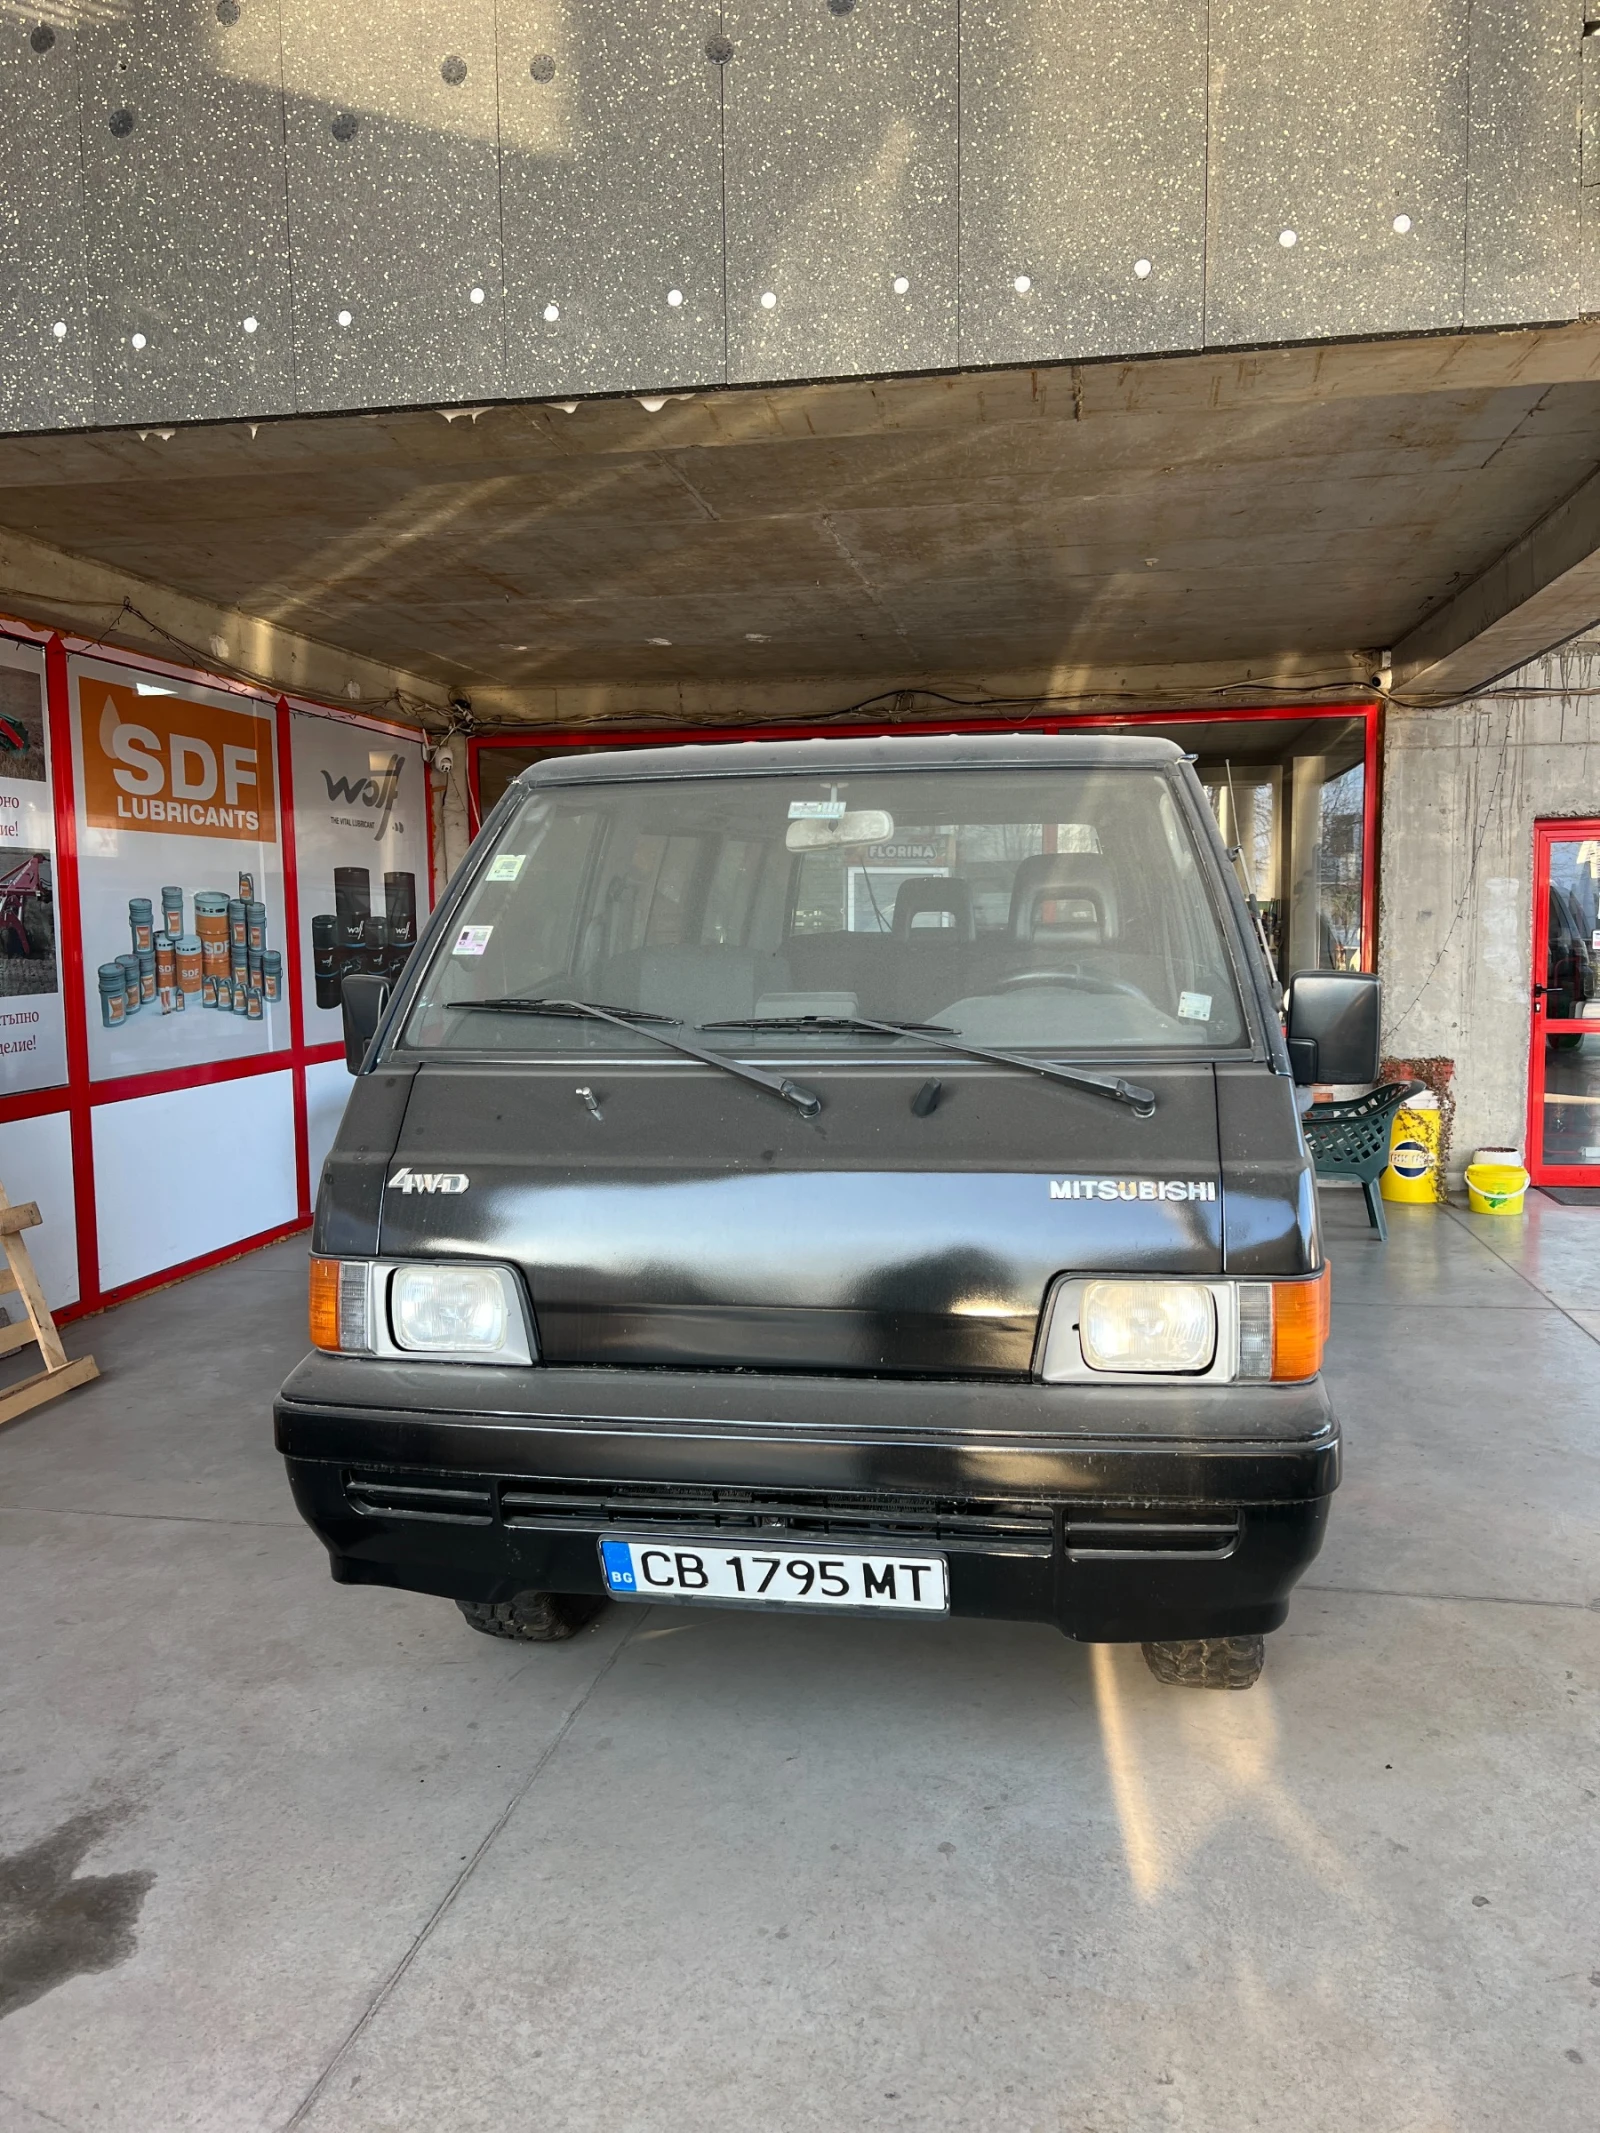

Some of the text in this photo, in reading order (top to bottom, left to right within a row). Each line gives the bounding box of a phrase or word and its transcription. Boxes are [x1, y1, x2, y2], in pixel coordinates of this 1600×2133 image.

[113, 723, 257, 805] SDF
[320, 753, 406, 841] wolf
[117, 796, 259, 831] LUBRICANTS
[330, 816, 375, 829] THE VITAL LUBRICANT
[869, 845, 936, 858] FLORINA
[203, 941, 230, 954] SDF
[181, 968, 199, 977] SDF
[387, 1167, 470, 1194] 4WD
[1049, 1180, 1216, 1202] MITSUBISHI
[611, 1571, 633, 1584] BG
[641, 1550, 932, 1602] CB 1795 MT
